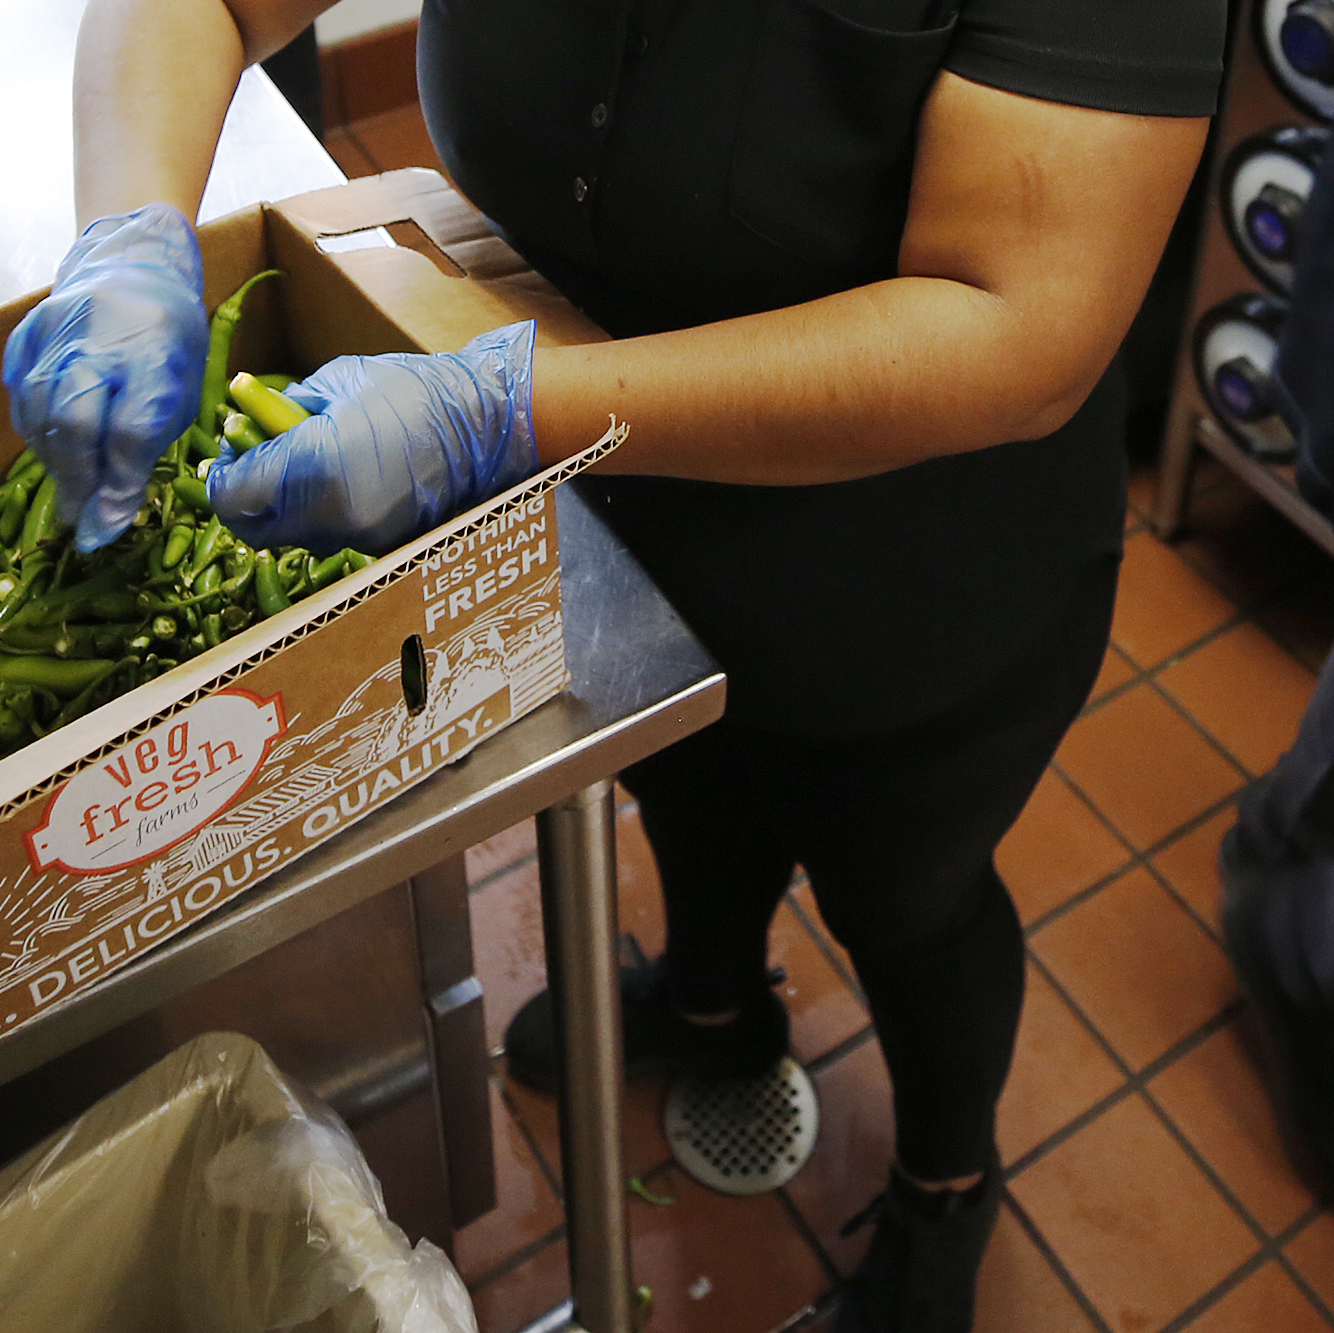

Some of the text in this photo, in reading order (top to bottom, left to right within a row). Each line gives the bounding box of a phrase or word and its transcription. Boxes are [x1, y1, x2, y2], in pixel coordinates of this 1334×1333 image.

[421, 495, 546, 578] NOTHING
[423, 516, 546, 602] LESS THAN
[425, 538, 547, 634] FRESH
[79, 733, 243, 846] fresh
[104, 719, 191, 790] veg
[133, 789, 200, 849] farms
[27, 844, 293, 1009] DELICIOUS.
[301, 716, 494, 841] QUALITY.
